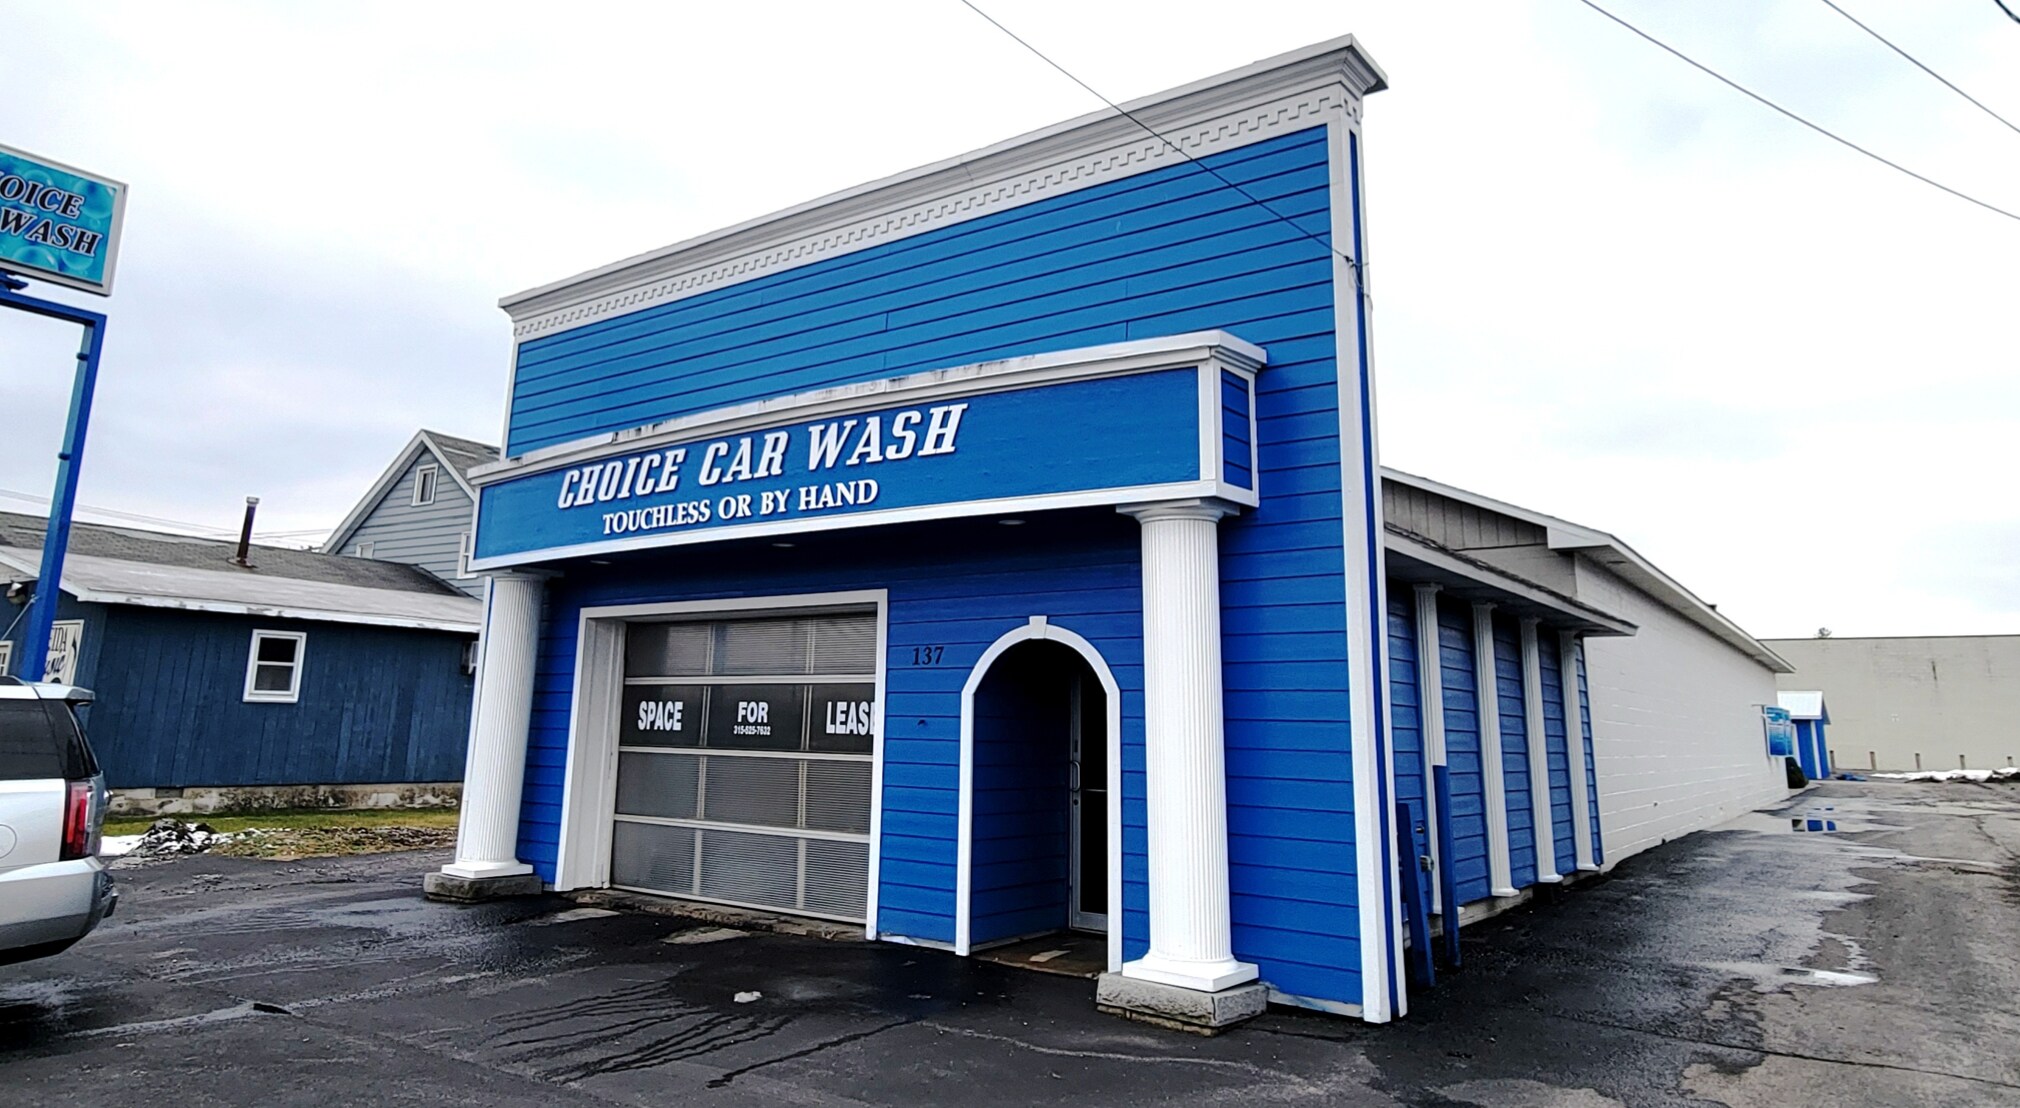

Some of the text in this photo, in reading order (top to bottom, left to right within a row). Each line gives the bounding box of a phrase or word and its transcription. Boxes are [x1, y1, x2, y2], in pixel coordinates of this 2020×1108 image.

[0, 174, 84, 218] OICE
[0, 207, 102, 257] WASH
[557, 402, 969, 509] CHOICE CAR WASH
[602, 478, 879, 535] TOUCHLESS OR BY HAND
[911, 645, 945, 666] 137
[637, 700, 684, 731] SPACE
[737, 701, 769, 723] FOR
